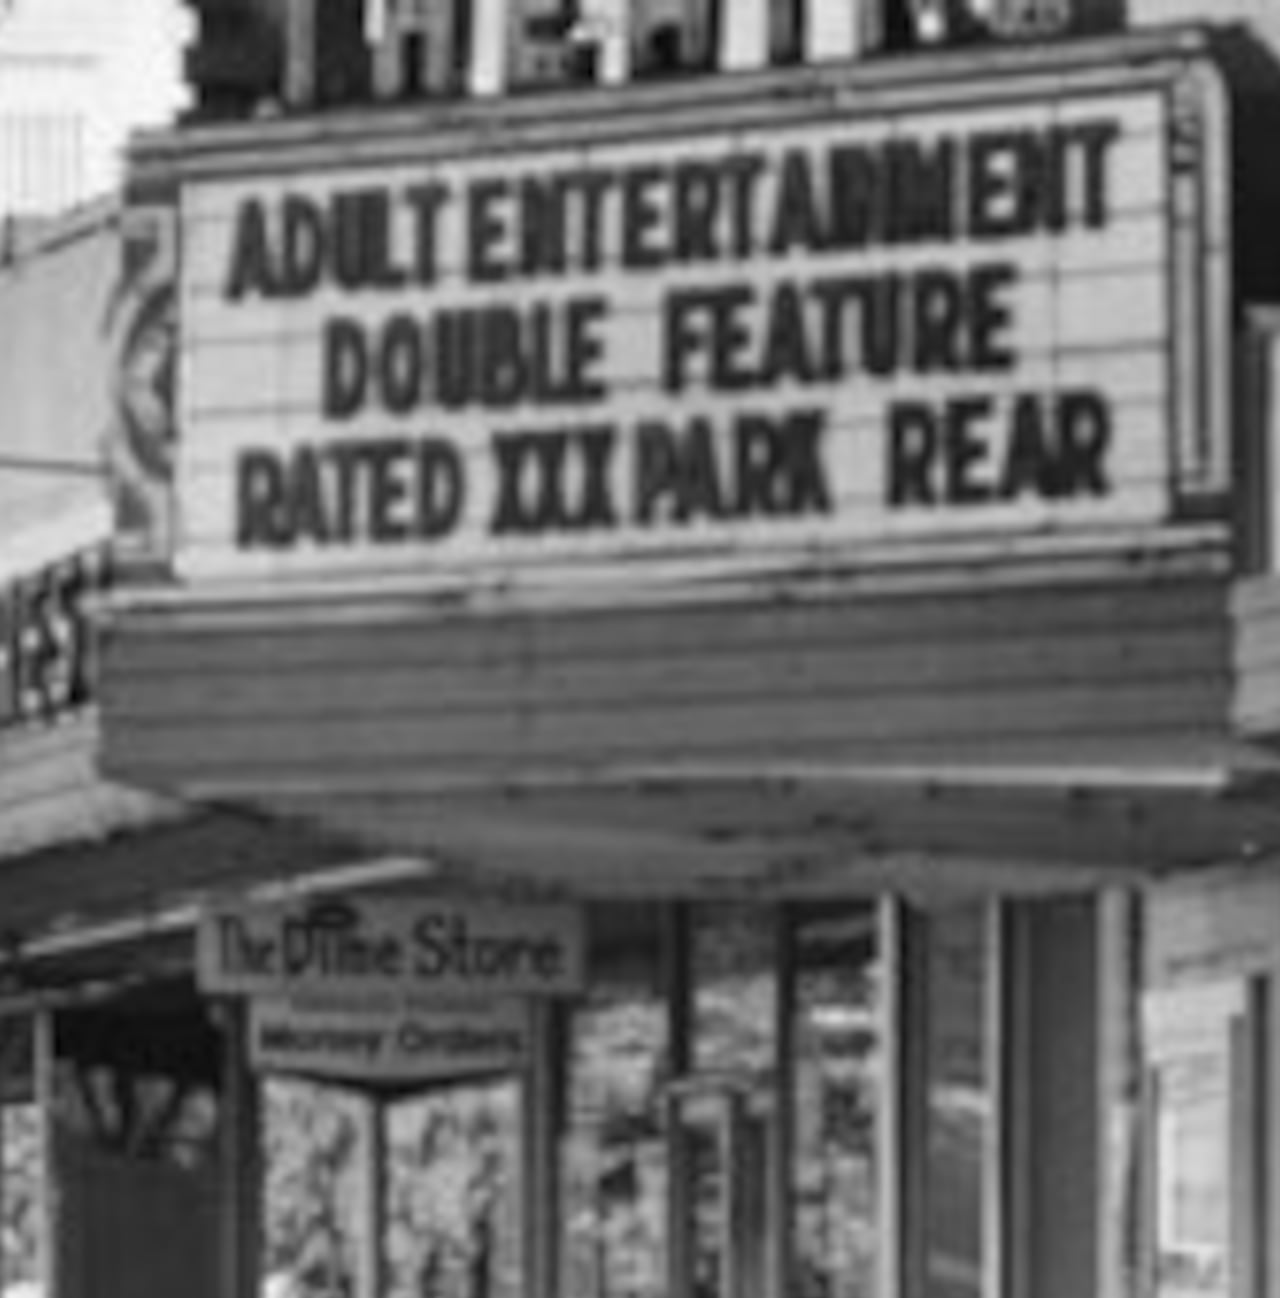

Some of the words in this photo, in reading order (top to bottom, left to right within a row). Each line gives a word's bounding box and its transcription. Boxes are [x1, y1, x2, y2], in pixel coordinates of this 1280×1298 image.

[227, 185, 446, 301] ADULT
[466, 122, 1118, 286] ENTERTAINMENT
[326, 298, 607, 418] DOUBLE
[662, 264, 1018, 394] FEATURE
[235, 433, 464, 549] RATED
[491, 421, 625, 536] XXX
[630, 409, 832, 528] PARK
[886, 392, 1111, 510] REAR
[412, 912, 565, 978] Store
